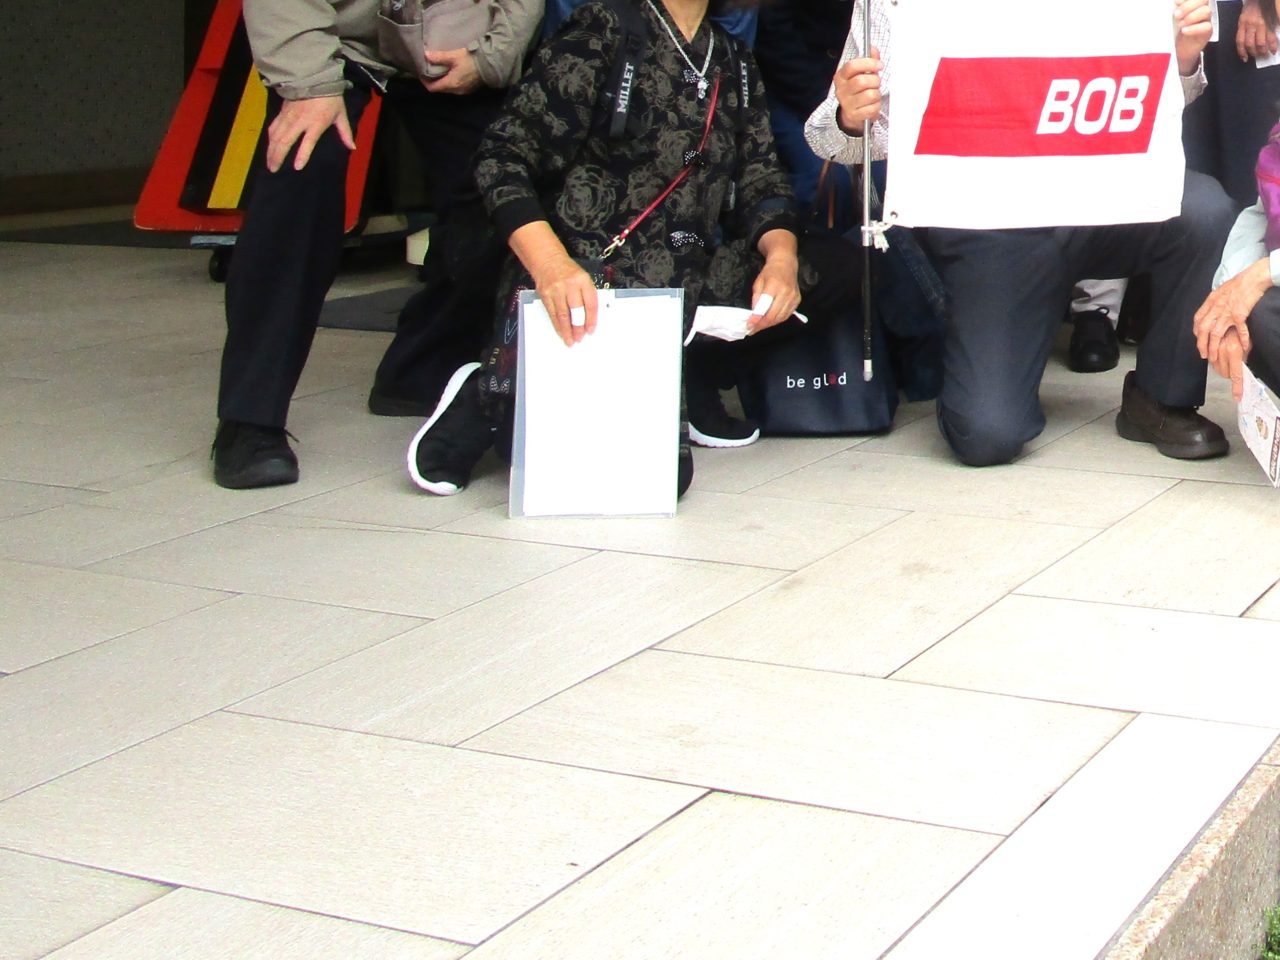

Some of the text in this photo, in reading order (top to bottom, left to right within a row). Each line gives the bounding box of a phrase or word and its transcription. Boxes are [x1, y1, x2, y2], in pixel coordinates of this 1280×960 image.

[616, 62, 635, 113] MILLET
[1036, 75, 1150, 135] BOB
[787, 376, 805, 388] be
